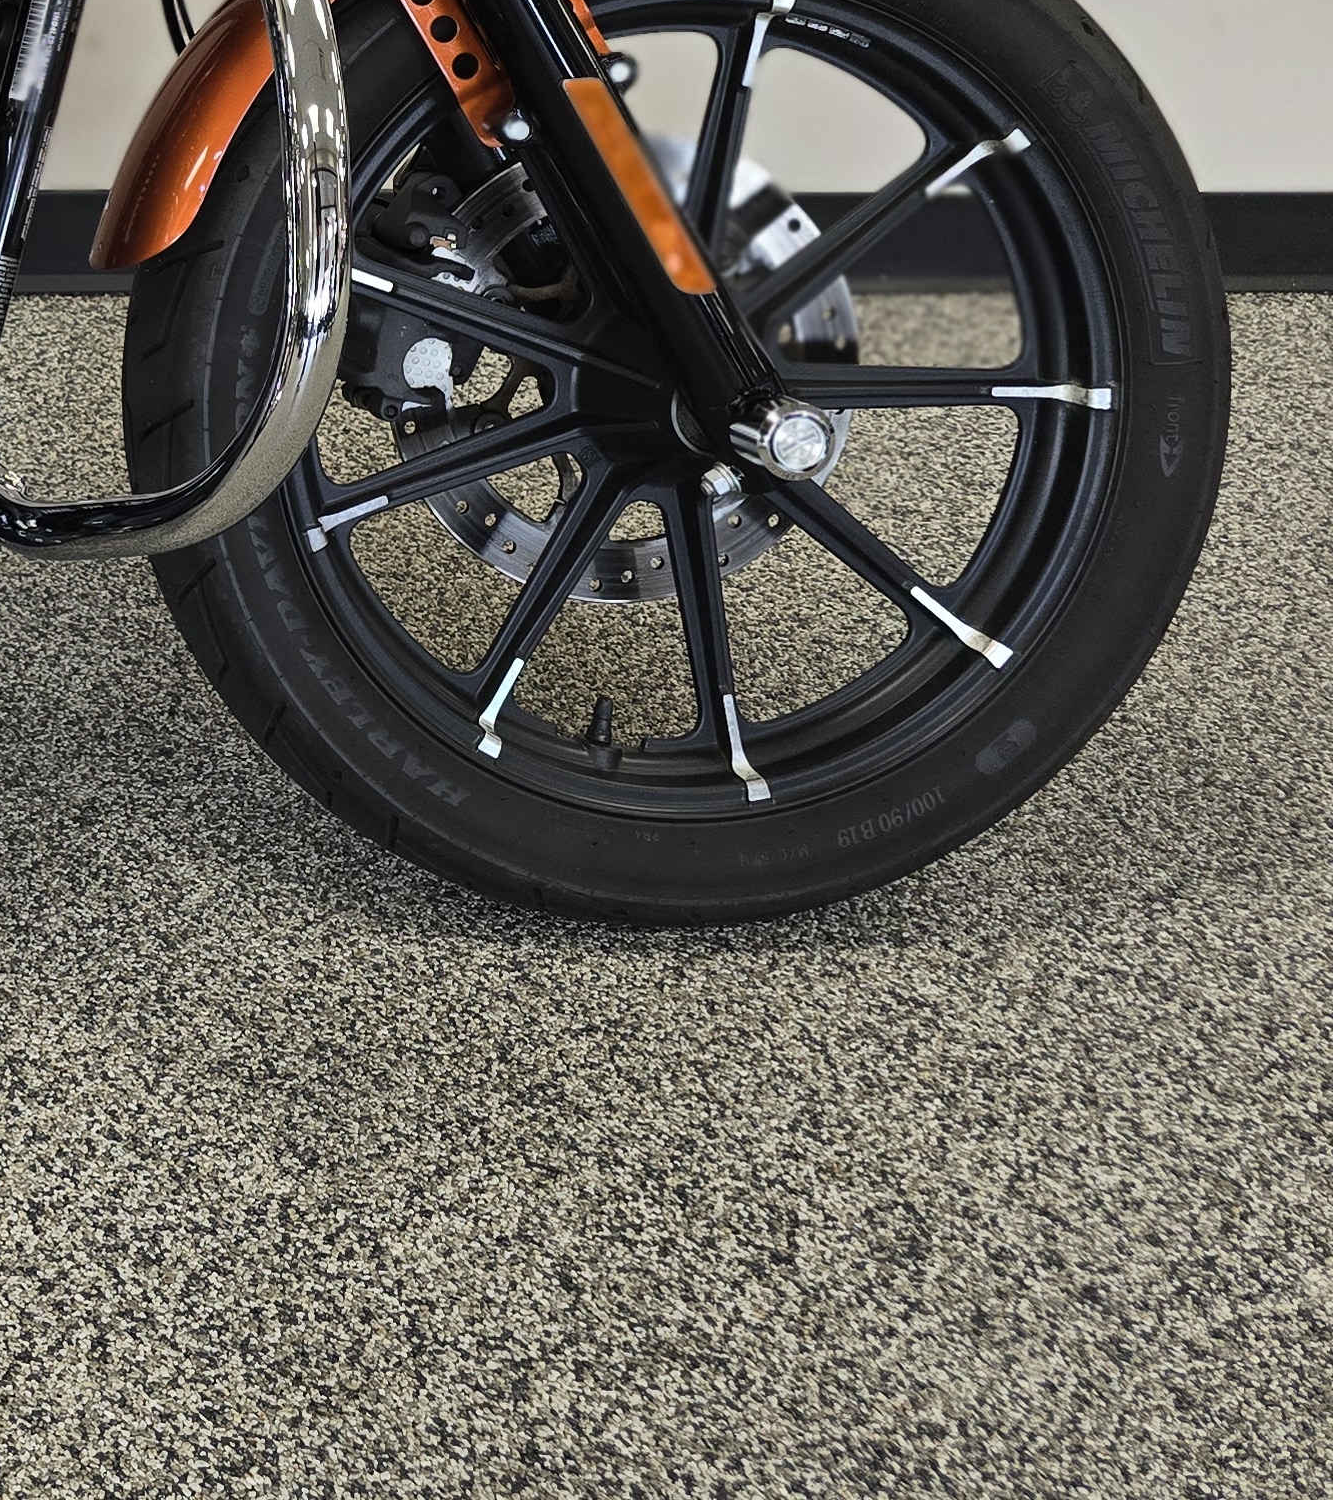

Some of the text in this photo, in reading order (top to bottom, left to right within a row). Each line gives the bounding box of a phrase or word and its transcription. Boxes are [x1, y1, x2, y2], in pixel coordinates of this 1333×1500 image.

[1091, 120, 1197, 360] MICHELIN
[835, 786, 947, 849] 100/90 B19
